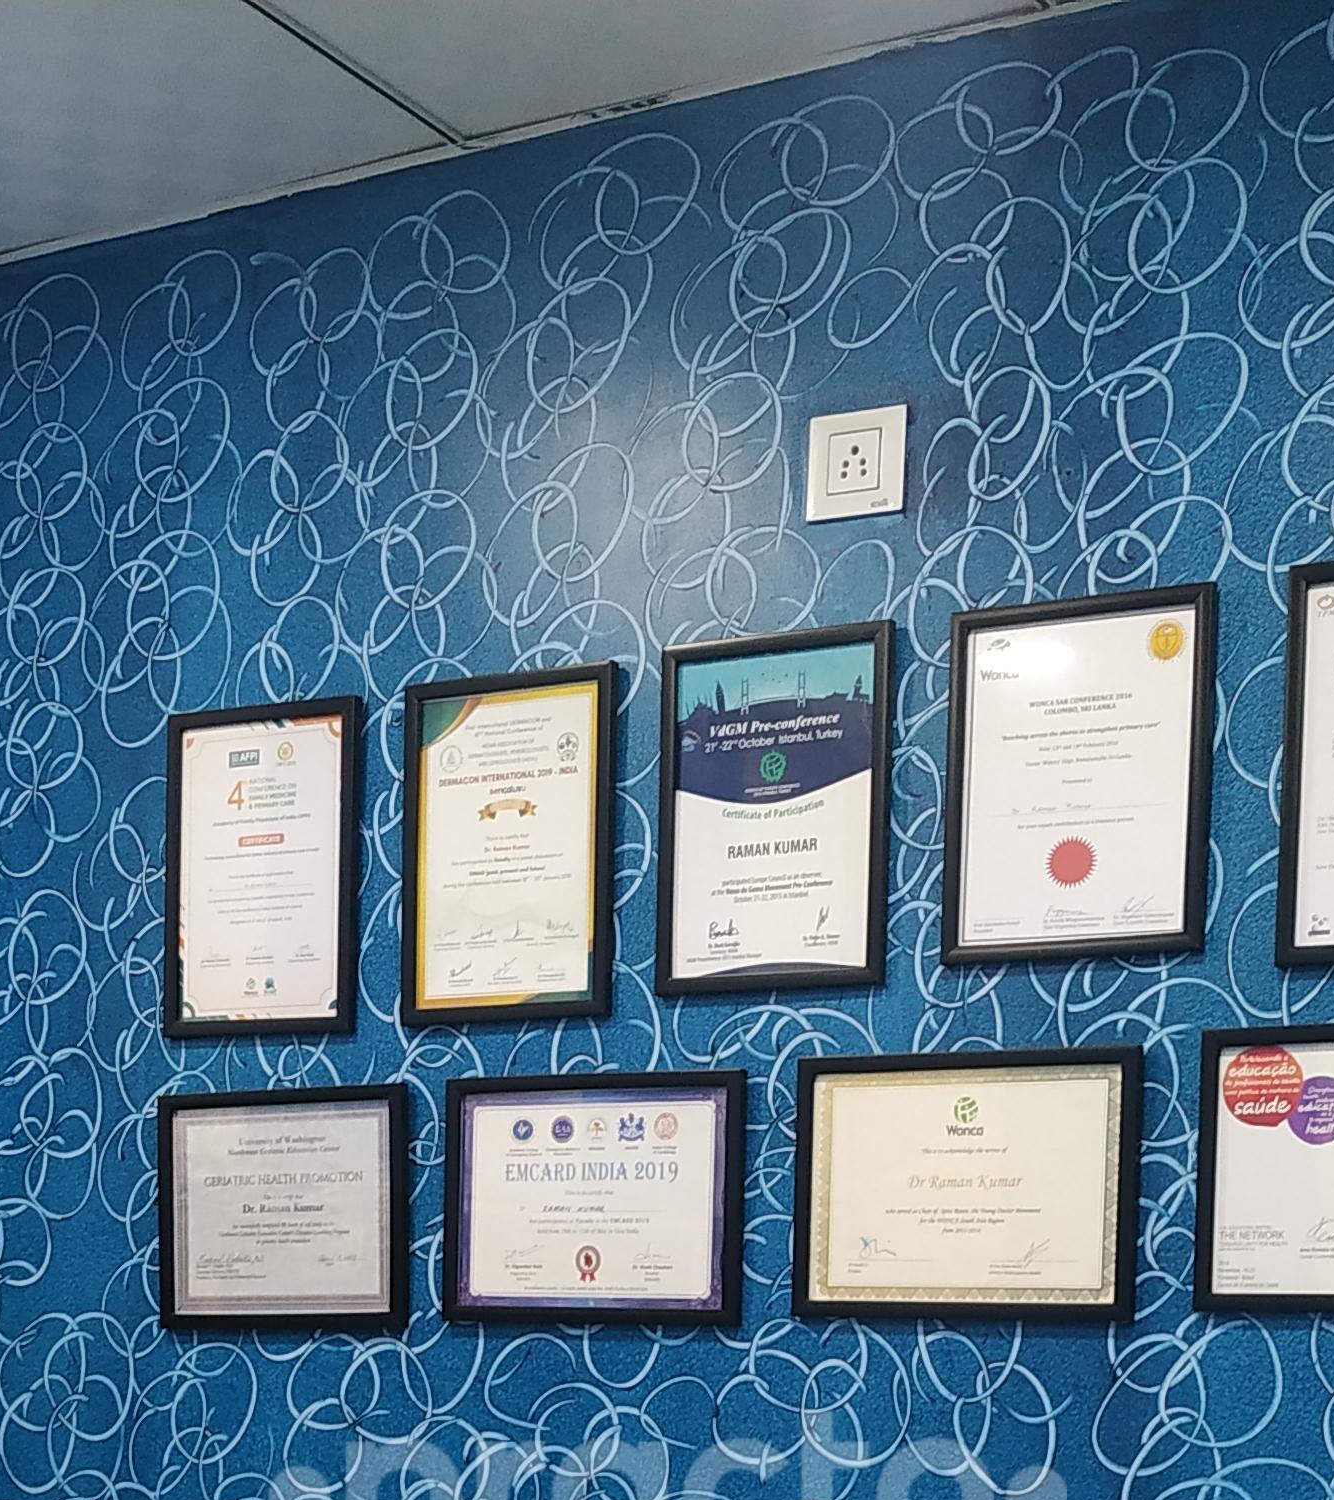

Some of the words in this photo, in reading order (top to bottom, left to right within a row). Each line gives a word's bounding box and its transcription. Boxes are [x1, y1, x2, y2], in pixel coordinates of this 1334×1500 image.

[1070, 694, 1114, 704] CONFERENCE
[1093, 703, 1116, 711] LANKA
[710, 722, 748, 738] VdGM
[751, 713, 840, 733] Pre-conference
[738, 736, 775, 749] October
[778, 732, 814, 745] Istanbul,
[816, 729, 843, 740] Turkey
[240, 751, 259, 762] AFPI
[439, 776, 479, 788] DERMACON
[481, 769, 535, 782] INTERNATIONAL
[537, 768, 553, 778] 2019
[559, 765, 578, 775] INDIA
[722, 808, 762, 819] Certificate
[764, 809, 773, 819] of
[774, 800, 825, 818] Participation
[728, 842, 770, 859] RAMAN
[774, 838, 818, 855] KUMAR
[1229, 1063, 1297, 1078] educação
[1234, 1095, 1291, 1115] saúde
[946, 1125, 984, 1137] Wonca
[204, 1175, 256, 1187] GERIATRIC
[258, 1173, 297, 1186] HEALTH
[299, 1170, 363, 1184] PROMOTION
[505, 1162, 576, 1182] EMCARD
[581, 1161, 628, 1181] INDIA
[634, 1161, 679, 1183] 2019
[907, 1175, 926, 1190] Dr
[929, 1176, 973, 1190] Raman
[977, 1174, 1022, 1189] Kumar
[243, 1204, 257, 1214] Dr.
[259, 1203, 291, 1213] Raman
[293, 1202, 324, 1212] Kumar
[1220, 1231, 1235, 1241] THE
[1239, 1231, 1284, 1240] NETWORK
